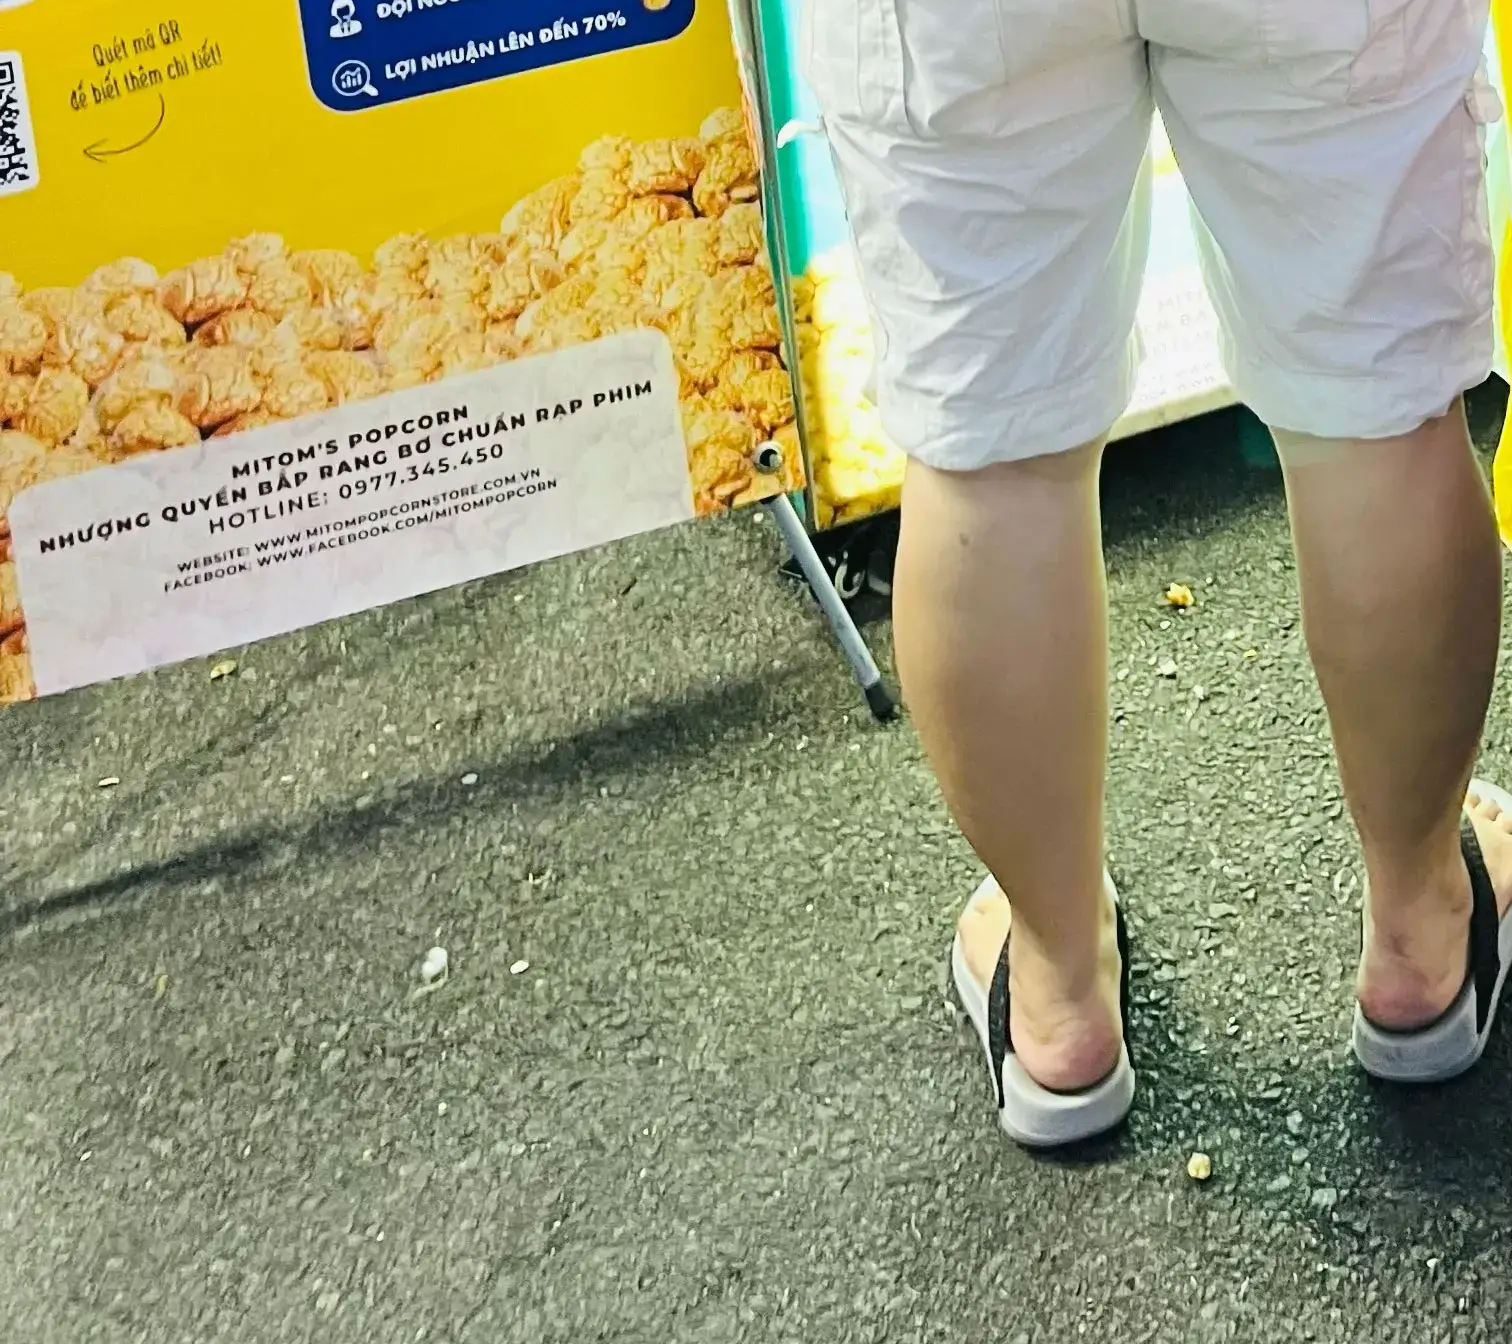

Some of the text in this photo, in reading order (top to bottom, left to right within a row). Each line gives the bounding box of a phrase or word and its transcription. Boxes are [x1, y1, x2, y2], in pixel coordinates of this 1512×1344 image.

[91, 68, 121, 104] biết
[124, 64, 163, 93] thêm
[167, 53, 190, 80] chi
[93, 19, 183, 67] Quét mã QR
[385, 10, 627, 82] LỢI NHUẬN LÊN ĐẾN 70%
[40, 511, 151, 553] NHƯỢNG
[258, 467, 309, 497] BẮP
[319, 450, 388, 480] RANG
[398, 434, 431, 459] BƠ
[593, 379, 652, 408] PHIM
[232, 404, 468, 480] MITOM'S POPCORN
[209, 443, 504, 535] HOTLINE: 0977.345.450
